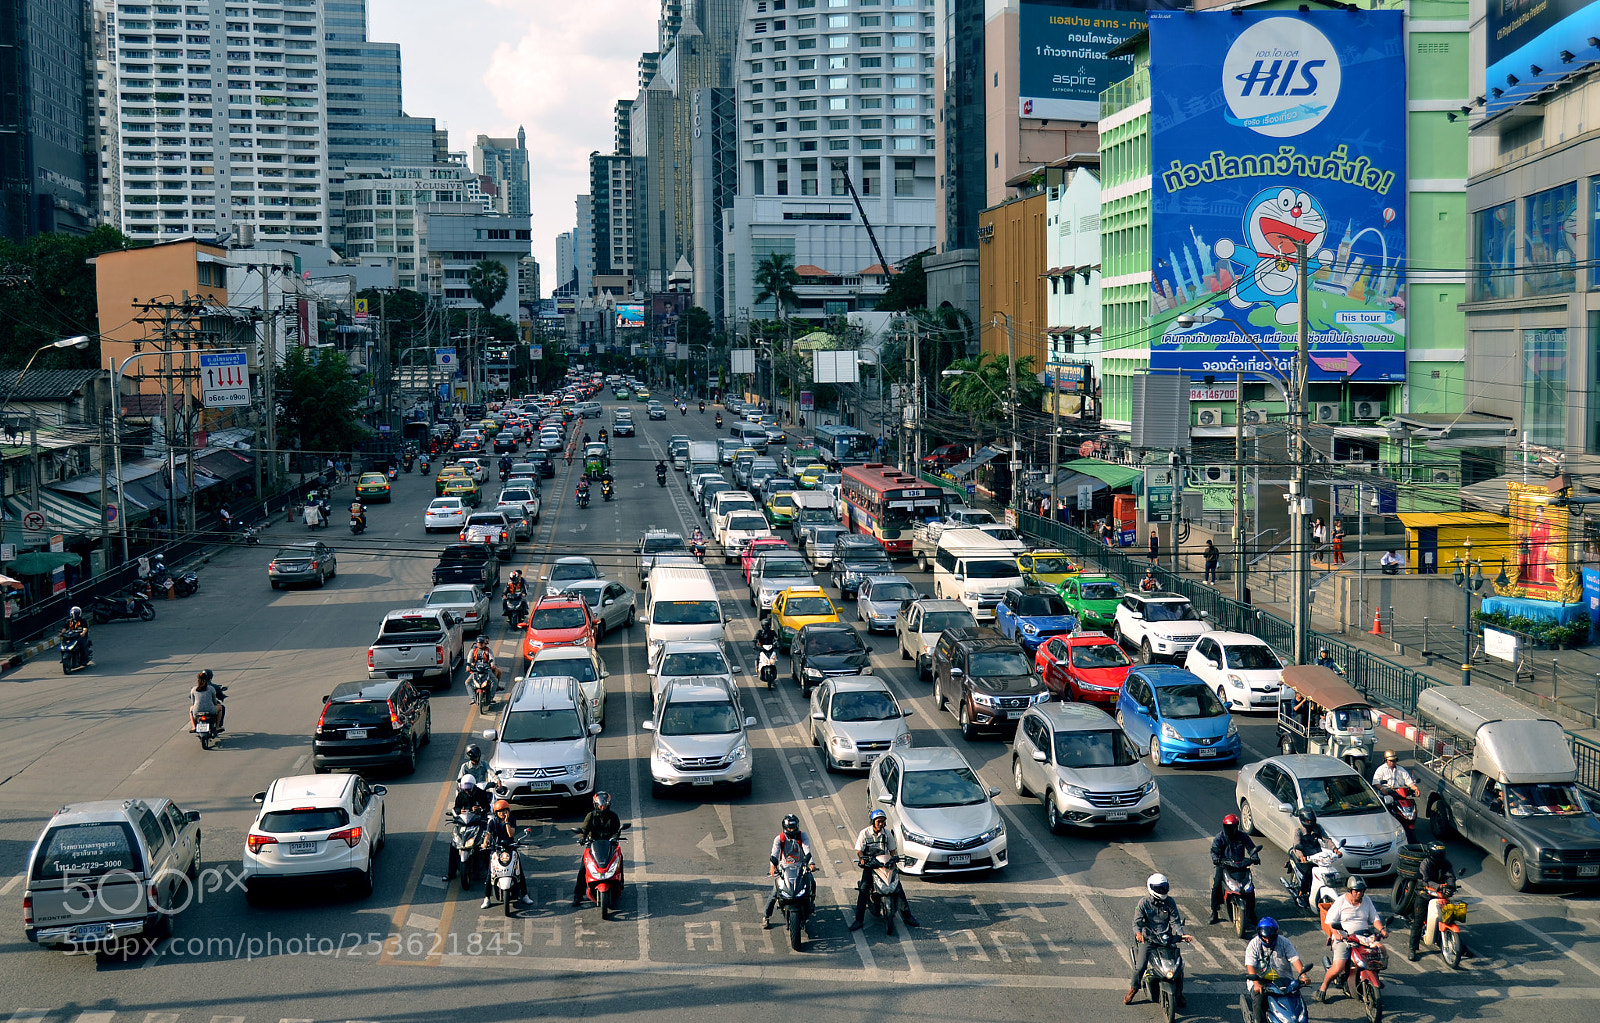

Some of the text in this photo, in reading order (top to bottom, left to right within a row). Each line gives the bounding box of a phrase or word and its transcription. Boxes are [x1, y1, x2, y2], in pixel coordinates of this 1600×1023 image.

[1050, 16, 1090, 27] แอสปาย
[1094, 18, 1119, 28] สาทร
[1036, 46, 1040, 55] 1
[1052, 74, 1096, 86] aspire
[694, 92, 702, 138] FICO
[1162, 144, 1396, 195] ท่องโลกกว้างดั่งใจ!
[414, 181, 462, 189] XCLUSIVE
[1342, 313, 1381, 322] his tour
[1161, 333, 1210, 344] เดินทางกับ
